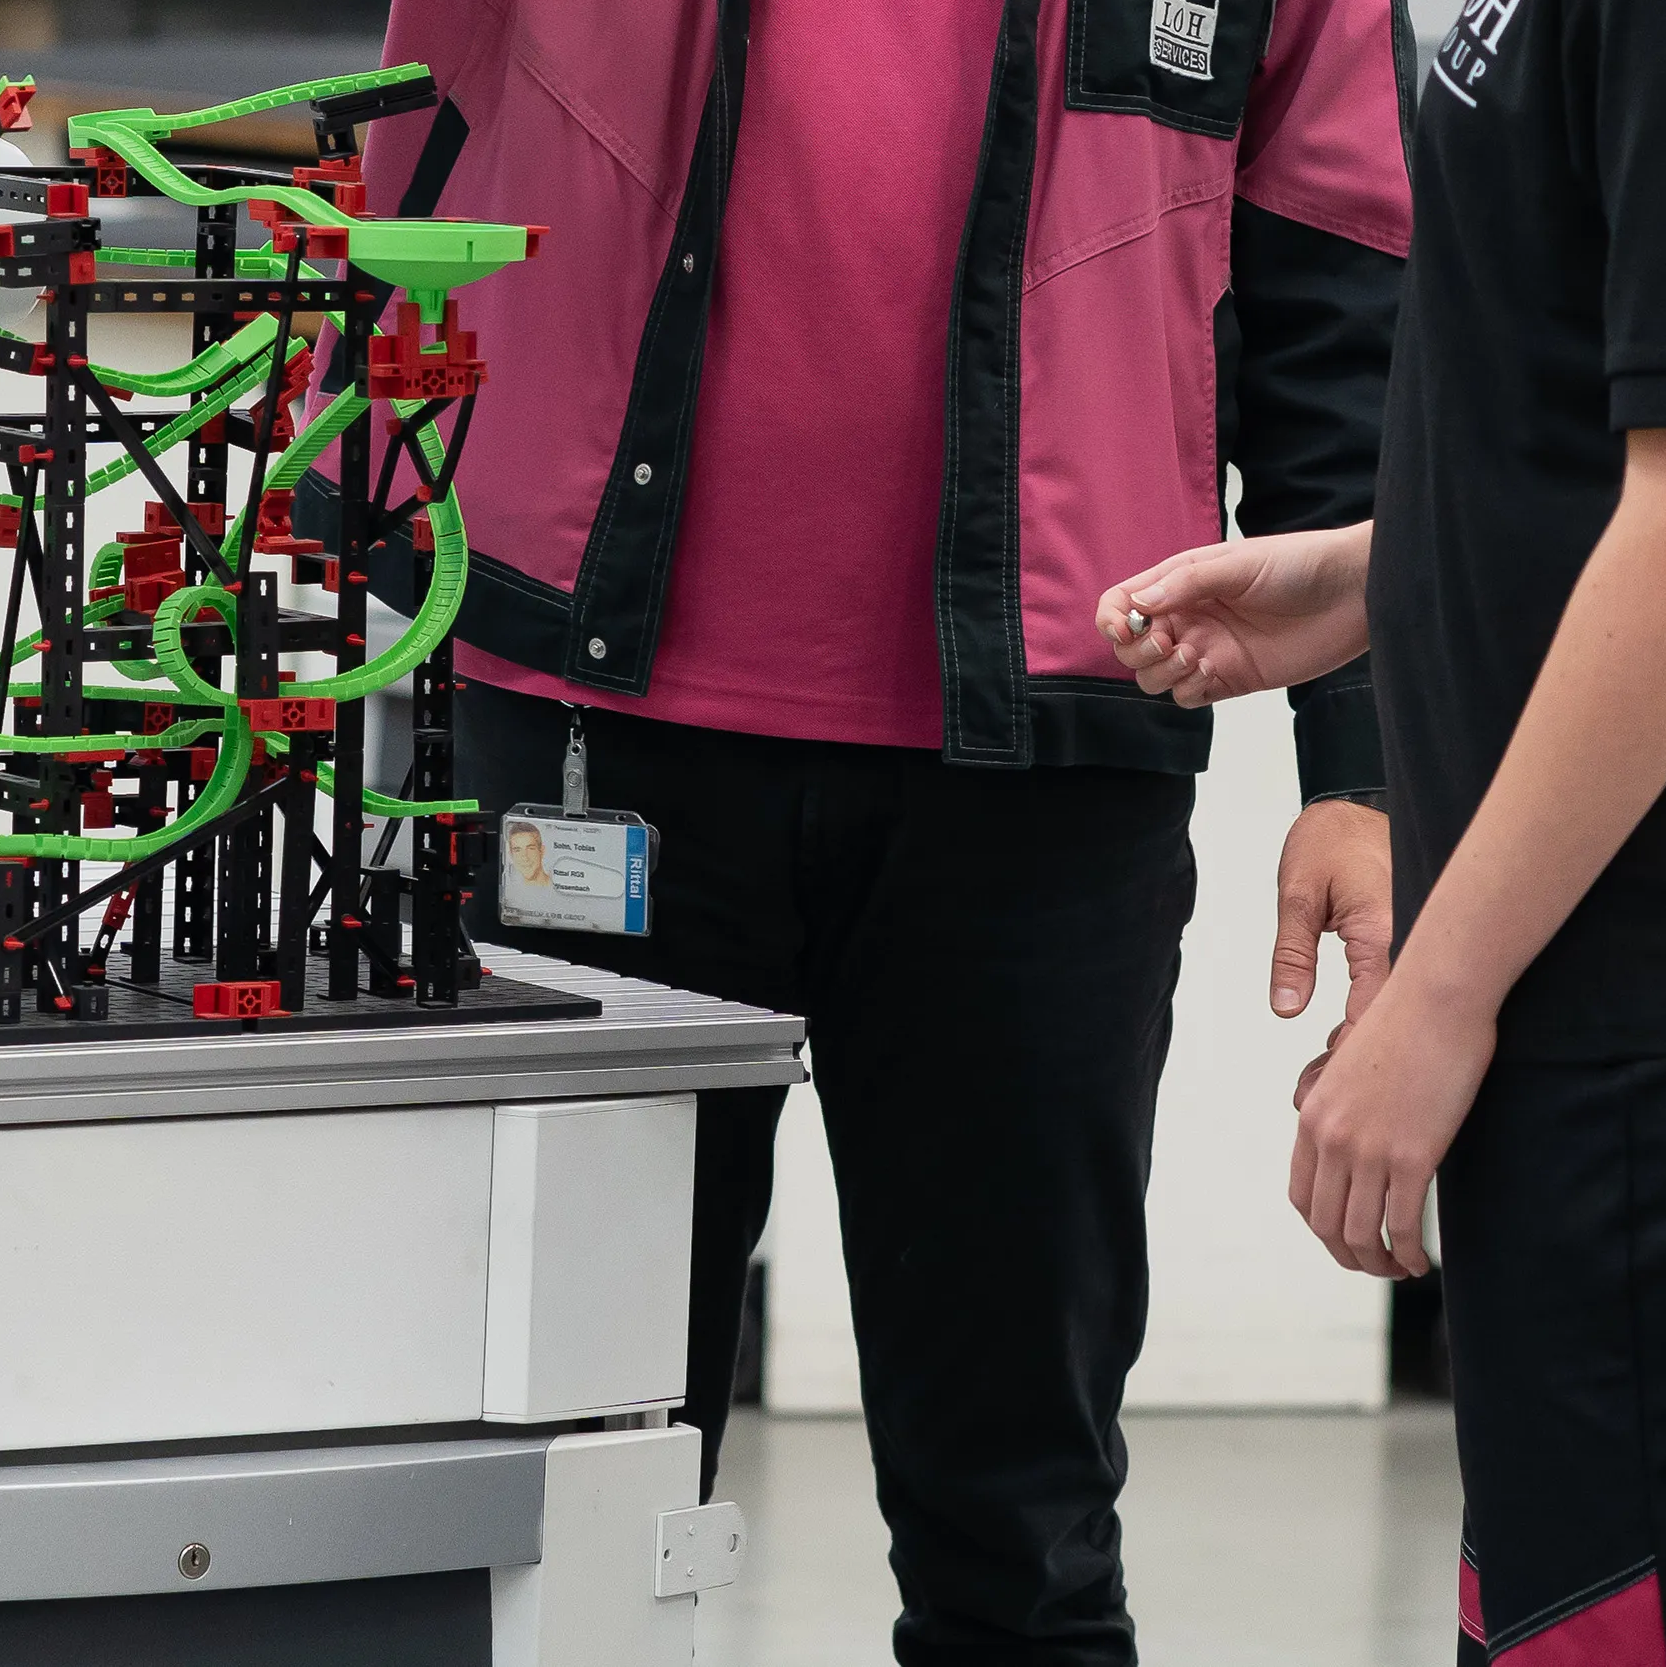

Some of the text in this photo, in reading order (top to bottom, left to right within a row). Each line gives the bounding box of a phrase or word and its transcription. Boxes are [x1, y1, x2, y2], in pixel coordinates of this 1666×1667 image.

[1161, 1, 1206, 40] LOH
[1154, 38, 1207, 72] SERVICES
[1442, 26, 1486, 86] OUP
[629, 857, 643, 899] Rittal
